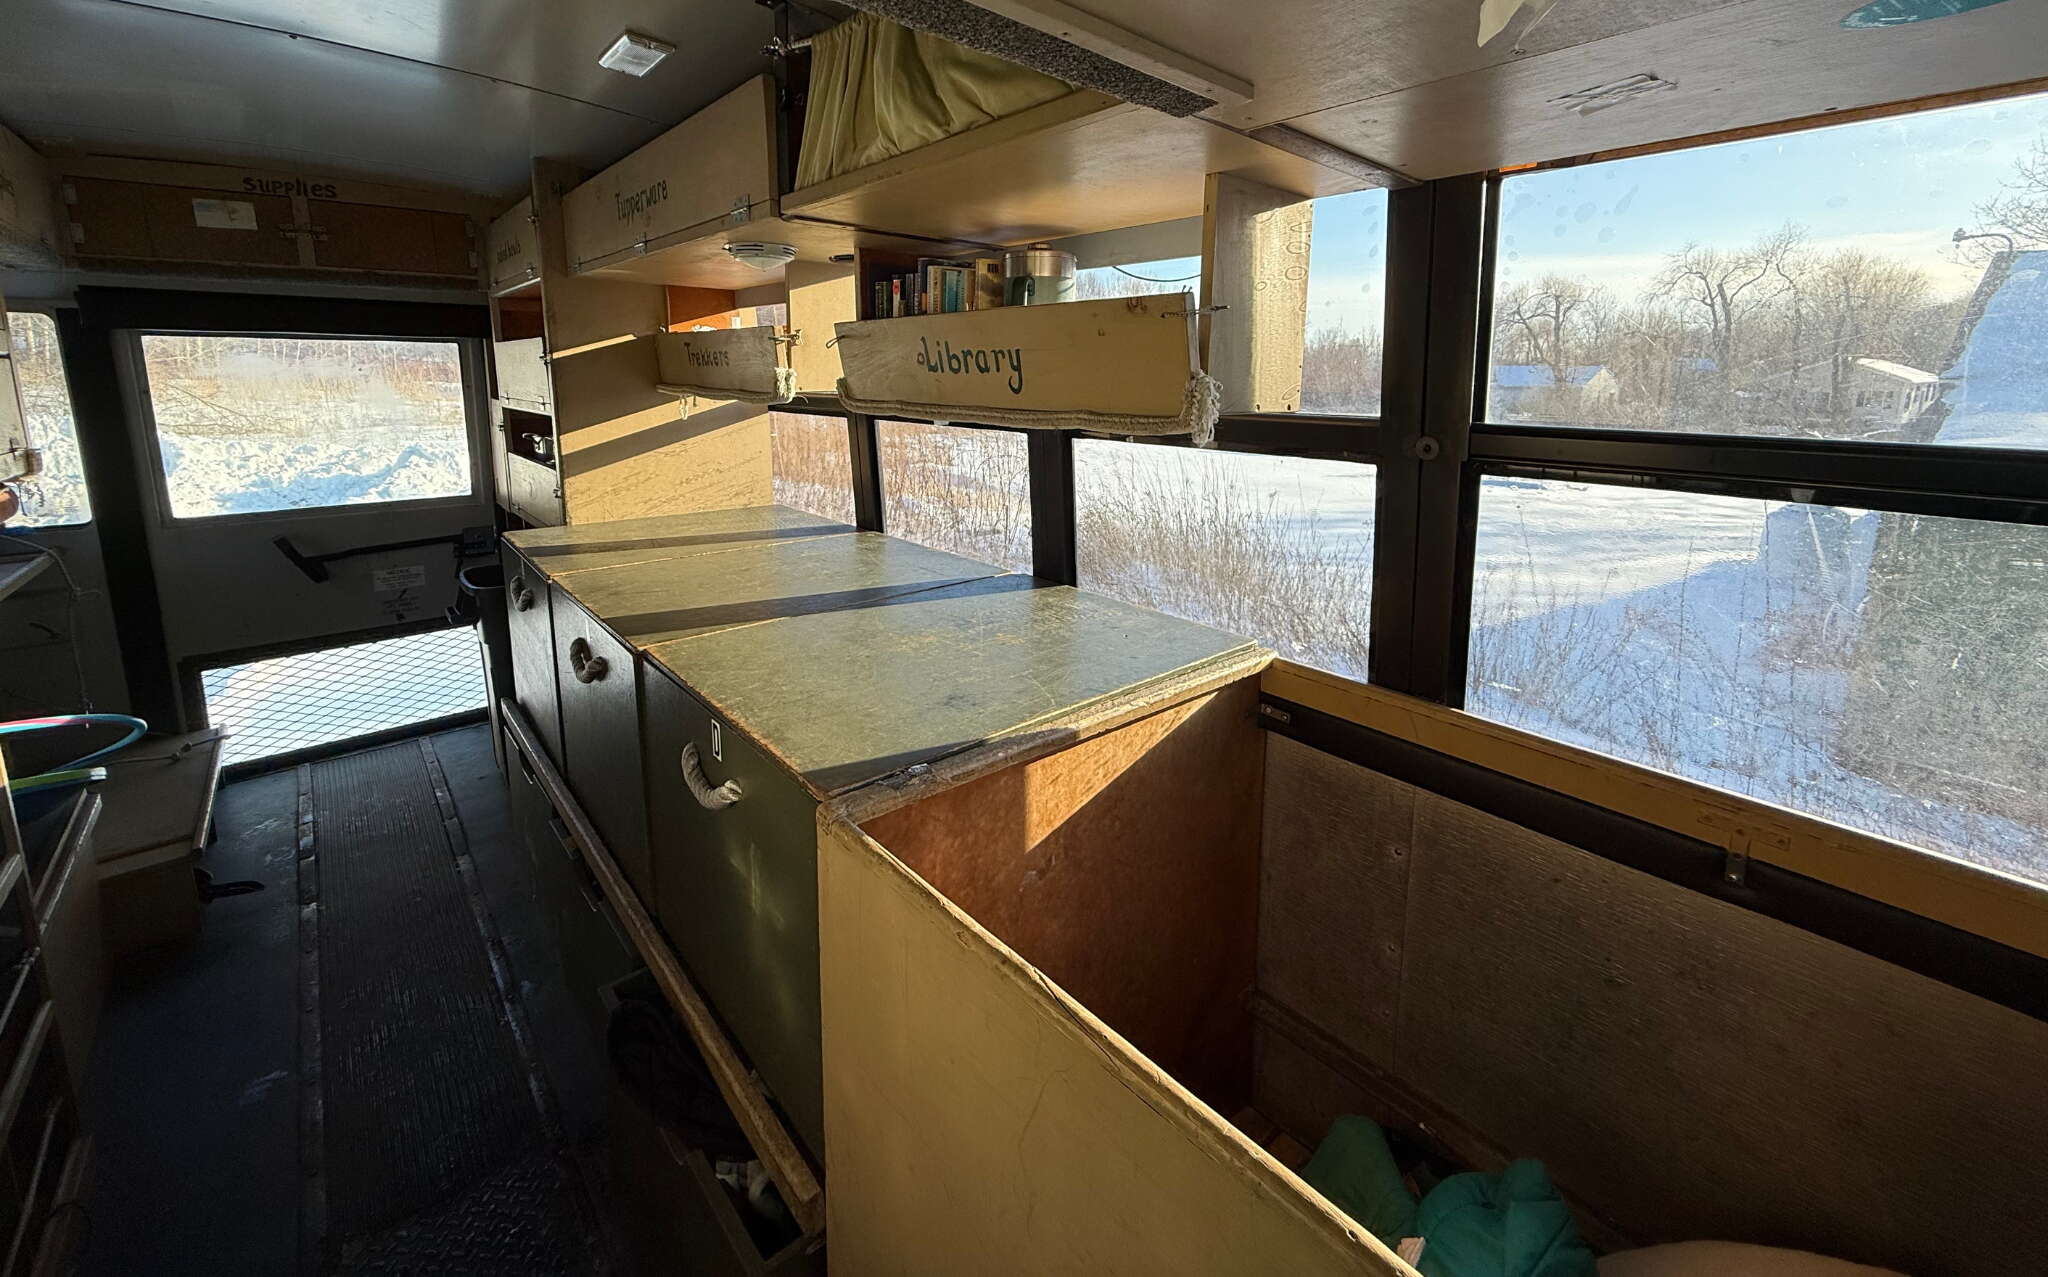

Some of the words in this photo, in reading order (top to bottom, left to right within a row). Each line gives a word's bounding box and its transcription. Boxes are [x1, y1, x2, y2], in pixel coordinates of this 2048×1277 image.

[615, 179, 668, 227] Tupperware
[683, 342, 730, 367] Trekkers
[919, 336, 1023, 395] Library
